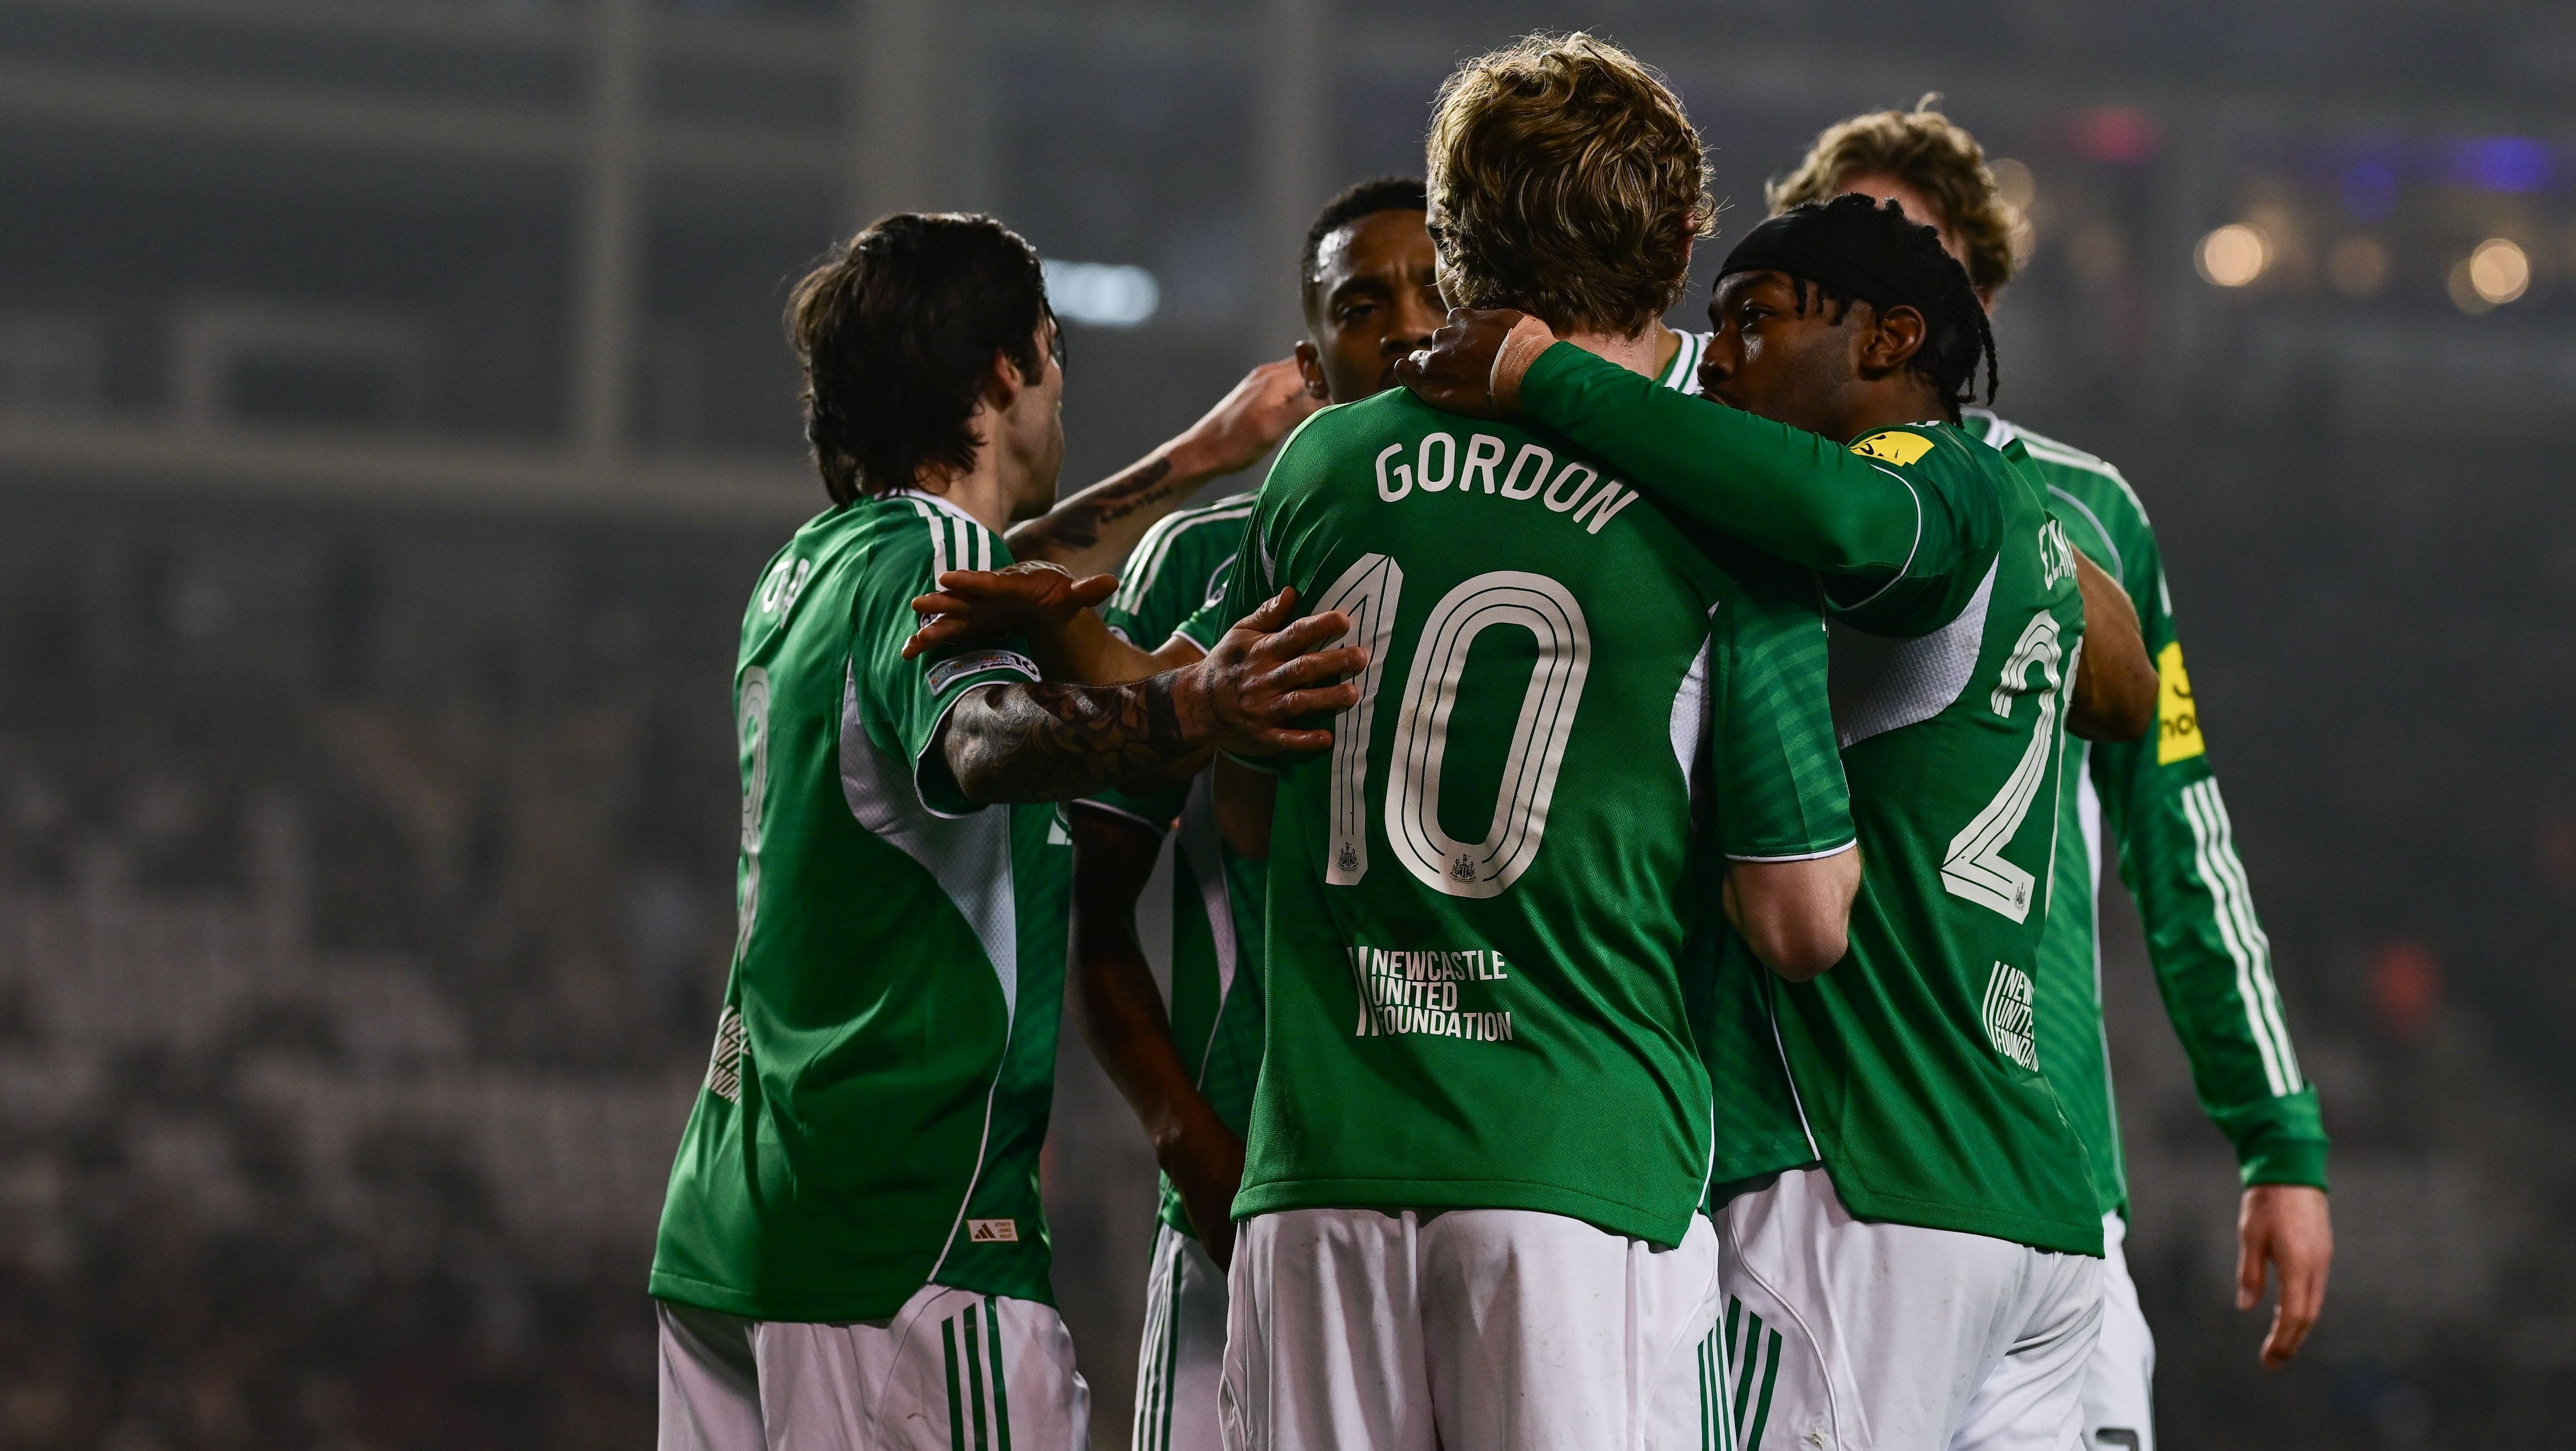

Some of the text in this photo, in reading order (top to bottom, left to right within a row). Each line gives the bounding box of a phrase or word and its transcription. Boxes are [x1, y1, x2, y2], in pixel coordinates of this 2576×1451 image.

[1376, 432, 1639, 535] GORDON
[1306, 552, 1591, 899] 10
[1941, 609, 2083, 925] 2
[1371, 948, 1507, 981] NEWCASTLE
[1371, 976, 1458, 1011] UNITED
[2002, 967, 2034, 1006] NEW
[1377, 1006, 1513, 1042] FOUNDATION
[1995, 996, 2034, 1040] UNITE
